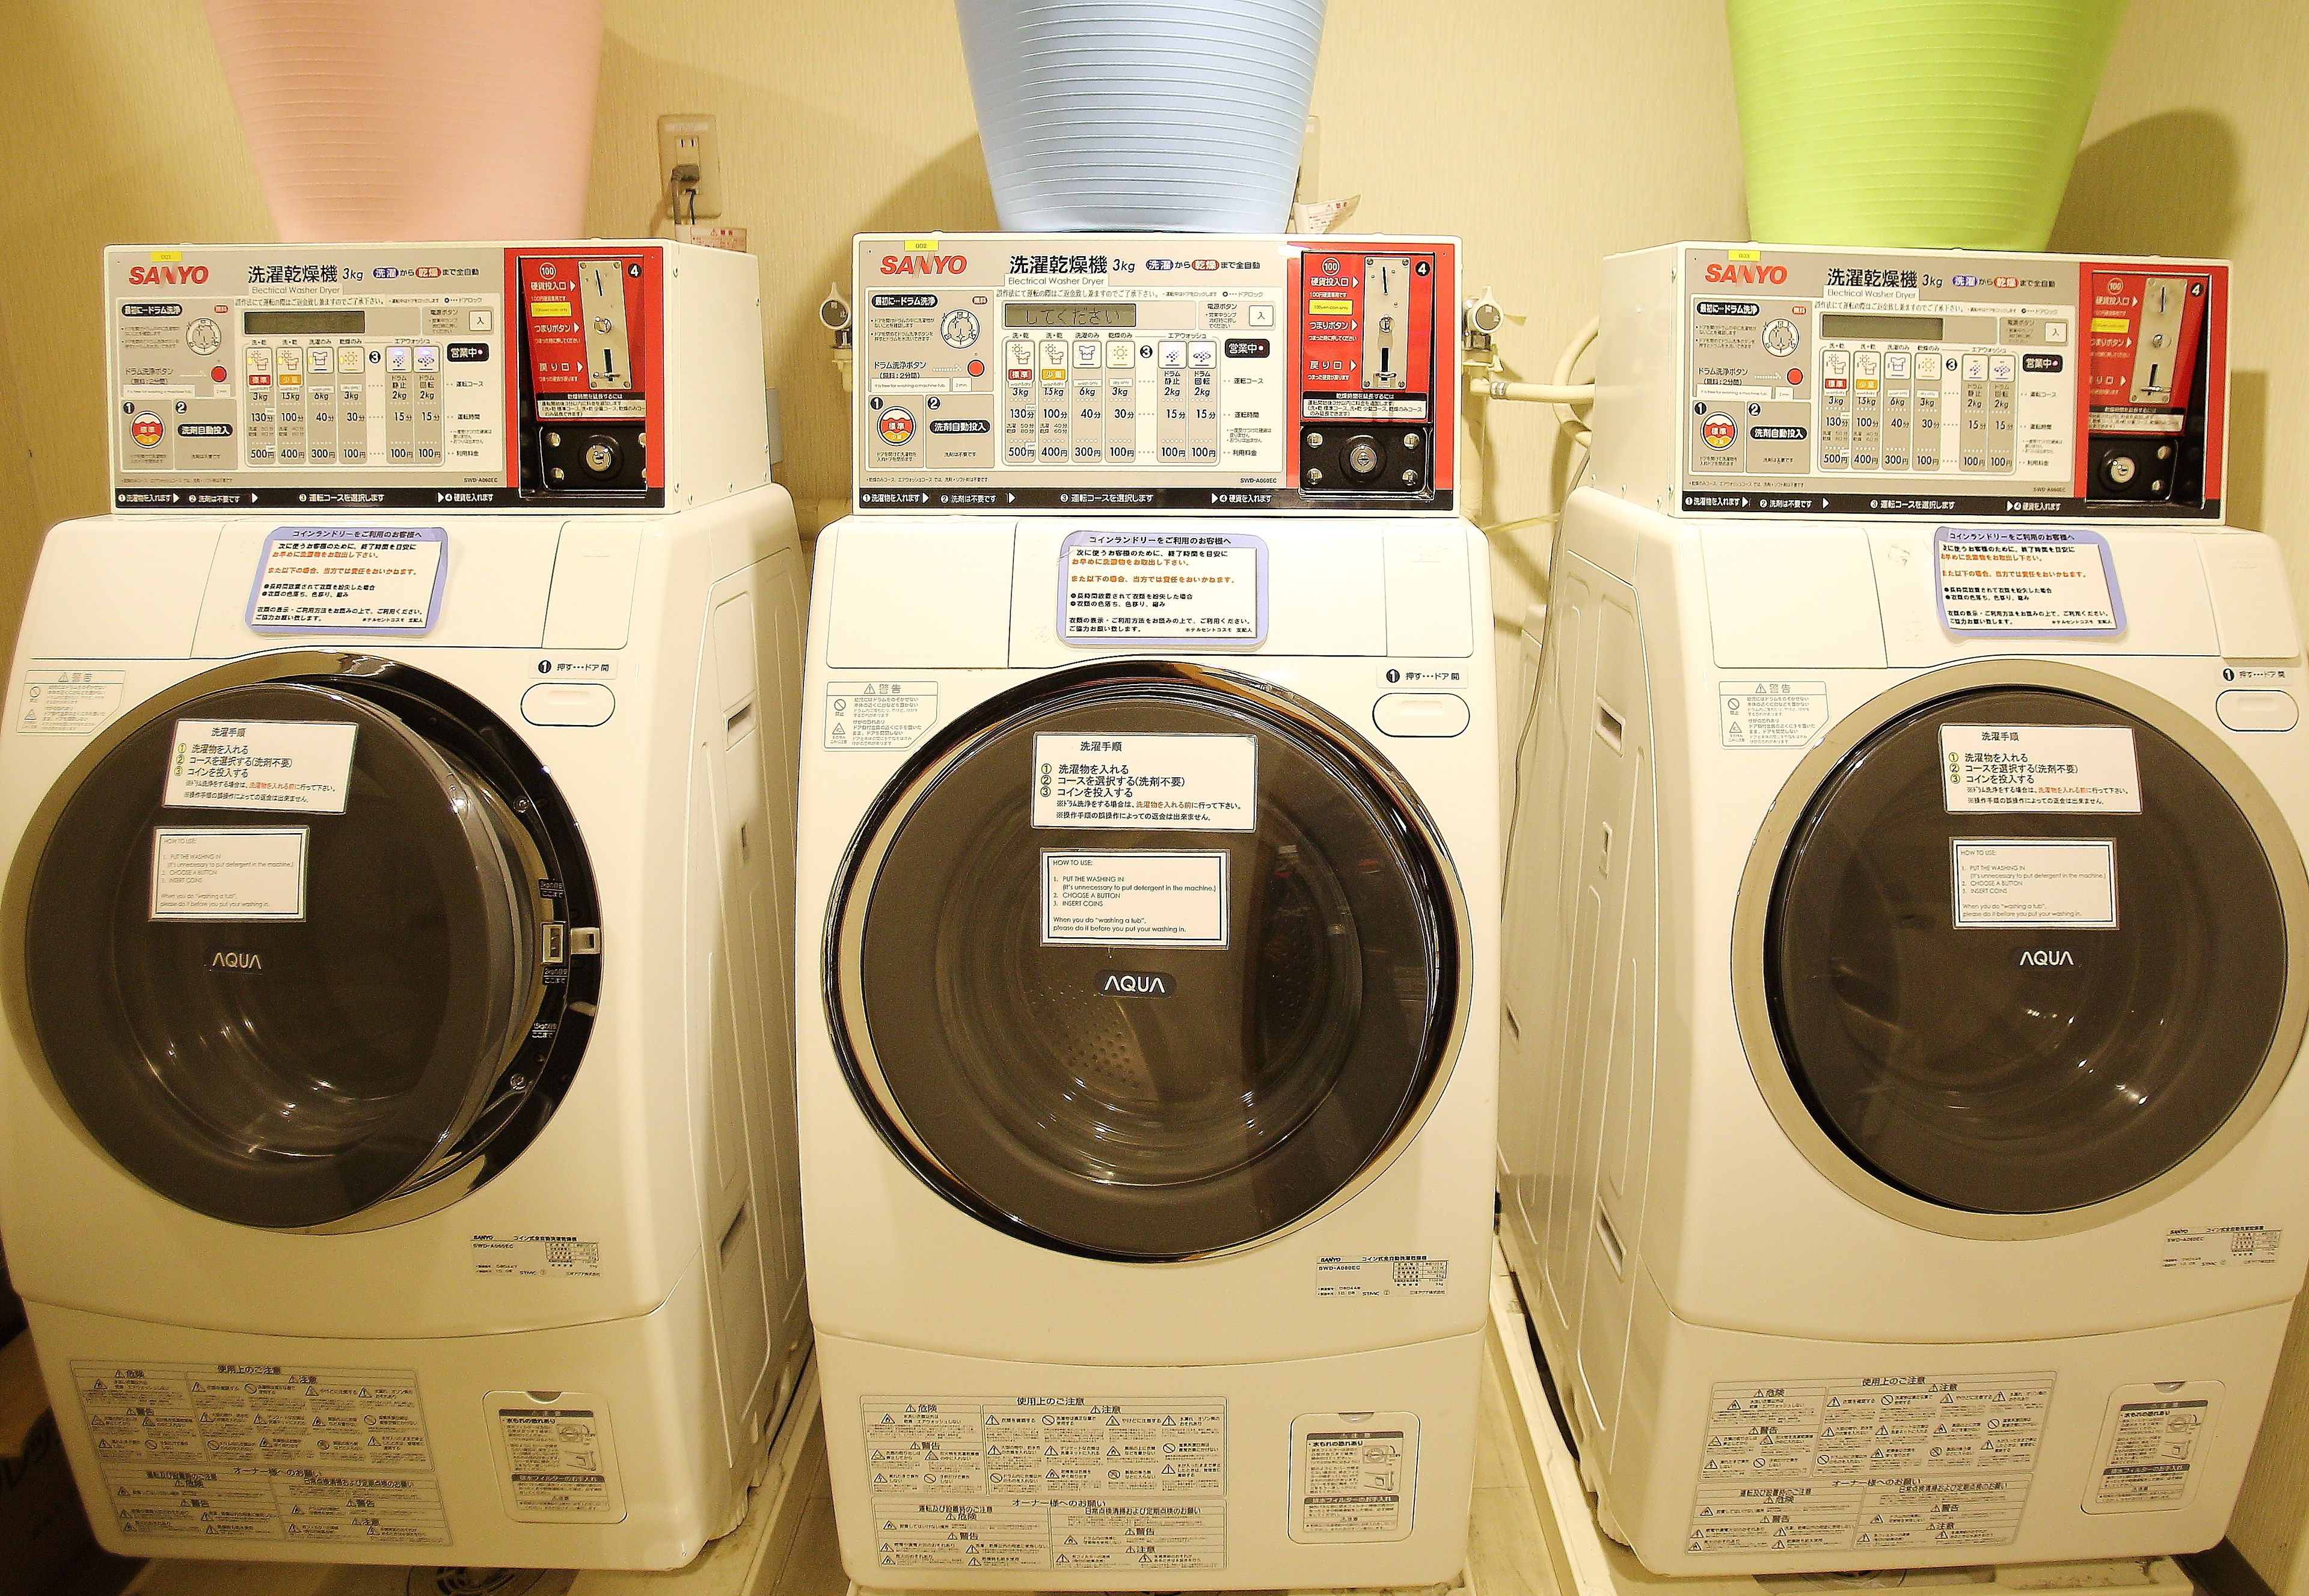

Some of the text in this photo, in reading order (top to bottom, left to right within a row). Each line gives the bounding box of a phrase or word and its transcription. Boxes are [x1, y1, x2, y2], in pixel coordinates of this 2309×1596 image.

[880, 256, 967, 275] SANYO
[1010, 255, 1107, 274] 洗濯乾燥機
[1113, 259, 1135, 272] 3kg
[1325, 263, 1337, 271] 100
[129, 267, 209, 284] SANYO
[248, 265, 363, 283] 洗濯乾燥機 3kg
[541, 267, 553, 275] 100
[1705, 264, 1787, 284] SANYO
[1082, 278, 1104, 286] Dryer
[1311, 278, 1349, 286] 硬貨投入口
[1827, 268, 1942, 288] 洗濯乾燥機 3kg
[320, 287, 340, 295] Dryer
[1896, 291, 1916, 300] Dryer
[1025, 307, 1121, 325] してください
[1309, 322, 1349, 330] つまりボタン
[451, 348, 477, 358] 営業中
[1228, 343, 1257, 353] 営業中
[1013, 388, 1029, 397] 3kg
[1079, 387, 1095, 397] 6kg
[1112, 387, 1127, 397] 3kg
[1164, 387, 1180, 396] 2kg
[1194, 387, 1210, 396] 2kg
[1010, 409, 1216, 419] 130分 100分 40分 30分 15分 15分
[182, 426, 230, 435] 洗剤自動投入
[934, 423, 986, 432] 洗剤自動投入
[1755, 429, 1804, 438] 洗剤自動投入
[281, 450, 366, 459] 400円 300円 100円
[1008, 447, 1216, 457] 500円 400円 300円 100円 100円 100円
[1854, 455, 1939, 465] 400円 300円 100円
[211, 727, 245, 737] 洗濯手順
[1981, 732, 2019, 741] 洗濯手順
[192, 744, 248, 754] 洗濯物を入れる
[1081, 741, 1122, 751] 洗濯手順
[1964, 753, 2028, 762] 洗濯物を入れる
[187, 768, 248, 778] コインを投入する
[1059, 765, 1129, 774] 洗濯物を入れる
[1966, 774, 2034, 784] コインを投入する
[1058, 787, 1133, 798] コインを投入する
[212, 952, 262, 969] AQUA
[2019, 951, 2073, 965] AQUA
[1105, 975, 1165, 993] AQUA
